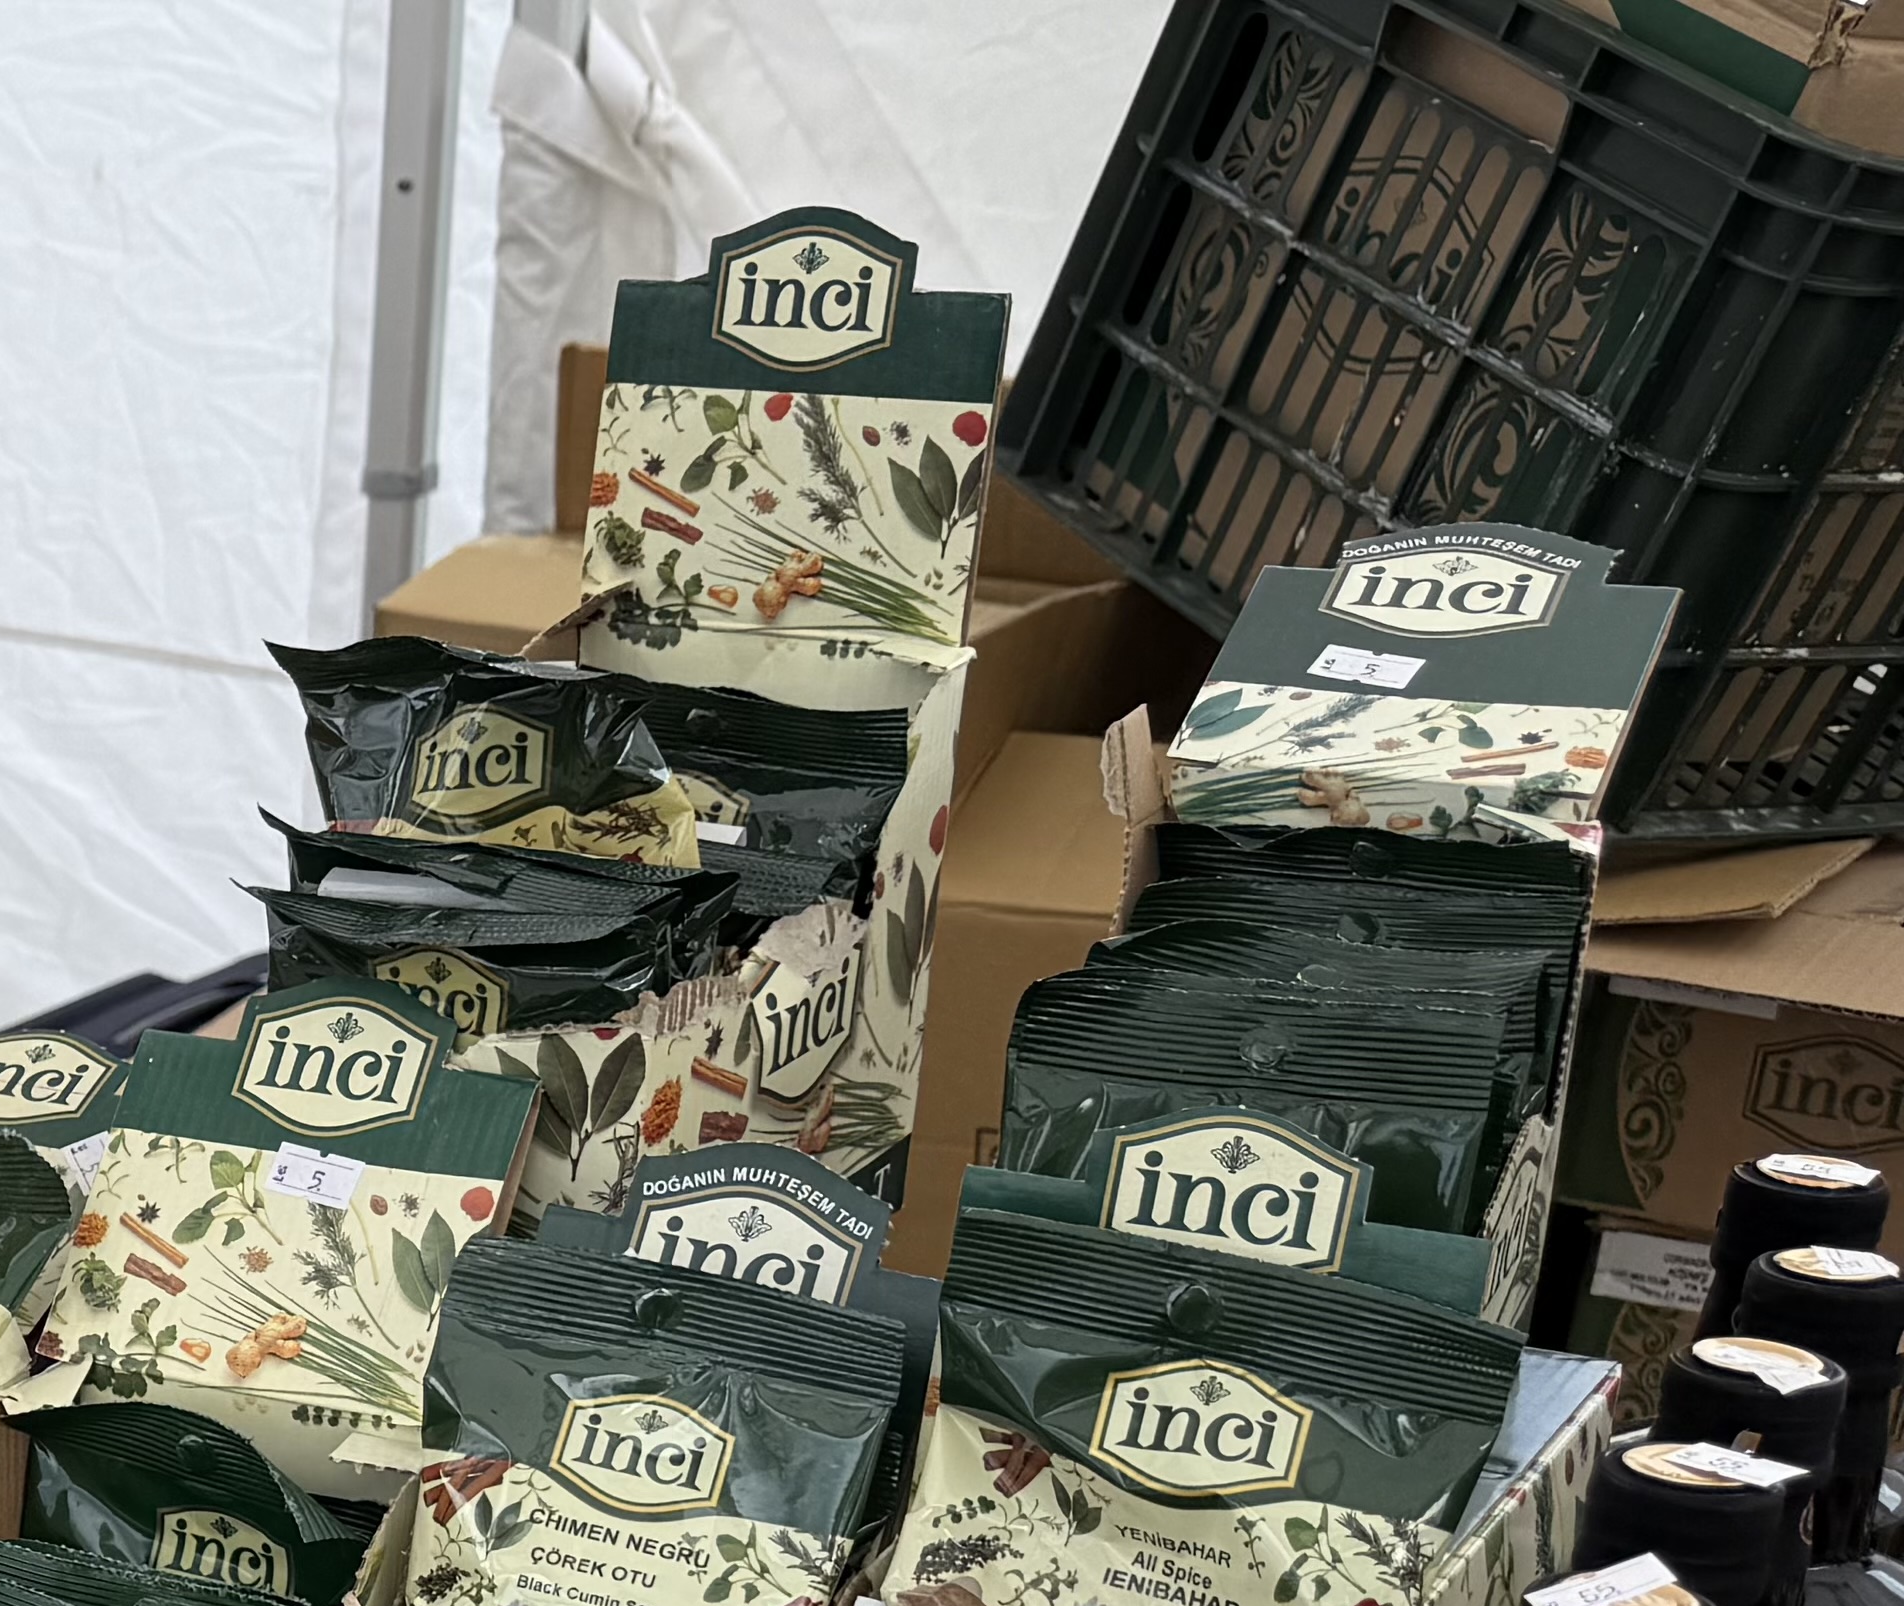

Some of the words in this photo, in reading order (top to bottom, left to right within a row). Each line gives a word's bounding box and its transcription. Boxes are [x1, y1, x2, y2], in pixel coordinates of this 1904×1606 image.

[732, 261, 873, 332] inci
[1347, 566, 1528, 615] inci
[419, 730, 534, 795] inci
[766, 960, 853, 1077] inci
[257, 1025, 408, 1104] inci
[642, 1167, 726, 1195] DOĞANIN
[732, 1166, 836, 1218] MUHTEŞEM
[834, 1208, 874, 1239] TADI
[1126, 1150, 1320, 1251] inci
[572, 1413, 707, 1492] inci
[1116, 1387, 1278, 1469] inci
[168, 1519, 278, 1593] inci
[528, 1507, 621, 1546] CHIMEN
[1115, 1524, 1232, 1568] YENİBAHAR
[516, 1573, 562, 1598] Black
[530, 1546, 606, 1578] ÇÖREK
[611, 1563, 657, 1589] OTU
[1132, 1551, 1159, 1571] All
[1161, 1558, 1213, 1590] Spice
